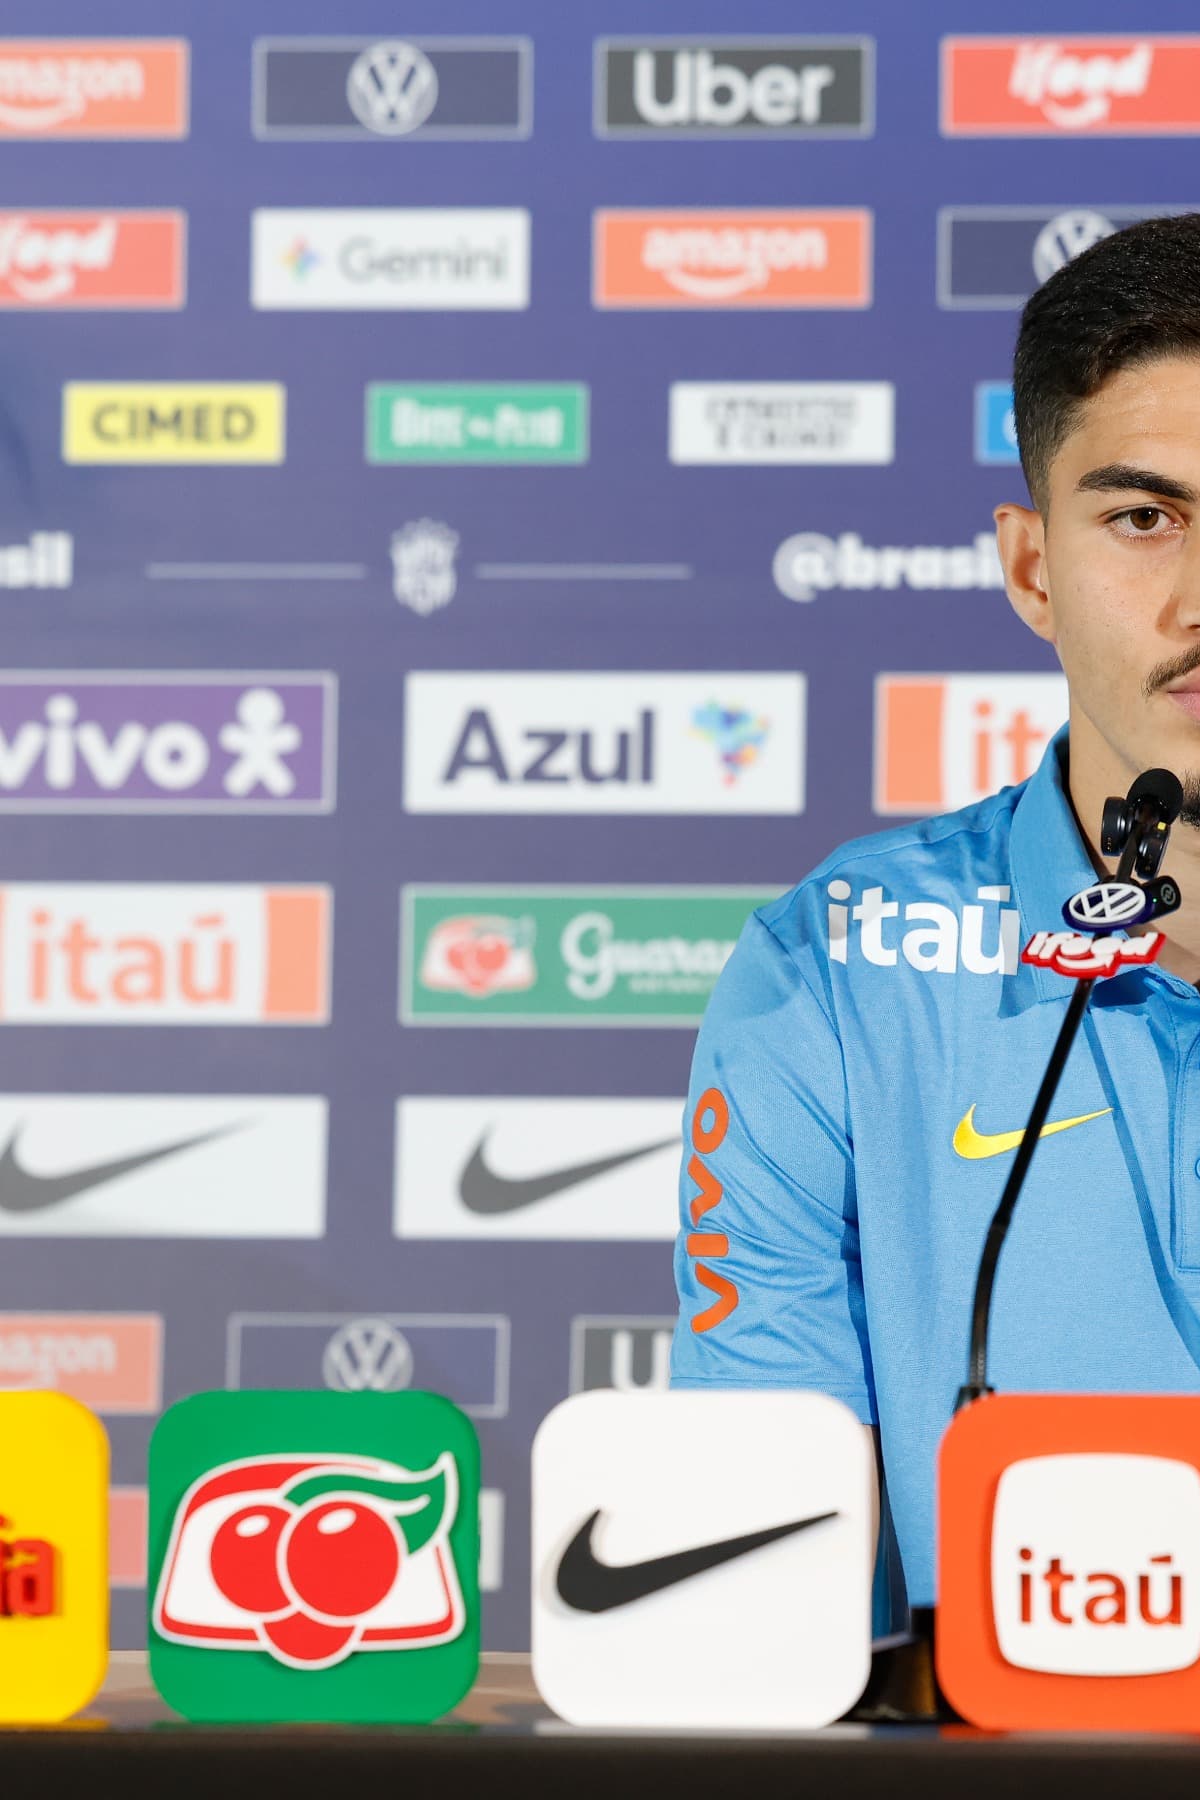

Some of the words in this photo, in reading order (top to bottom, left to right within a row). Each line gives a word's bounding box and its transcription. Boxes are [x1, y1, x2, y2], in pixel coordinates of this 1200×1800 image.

[0, 57, 143, 117] mazon
[634, 48, 831, 125] Uber
[0, 217, 117, 272] food
[338, 236, 508, 284] Gemini
[642, 229, 827, 284] amazon
[91, 402, 257, 446] CIMED
[772, 532, 1003, 602] @brasi
[0, 694, 209, 790] vivo
[440, 708, 656, 786] Azul
[973, 701, 1045, 792] it
[28, 909, 237, 1003] itaú
[560, 910, 736, 1000] Guara
[827, 877, 1020, 976] itaú
[686, 1087, 739, 1334] vivo
[0, 1332, 118, 1390] azon
[1018, 1548, 1183, 1627] itaú
